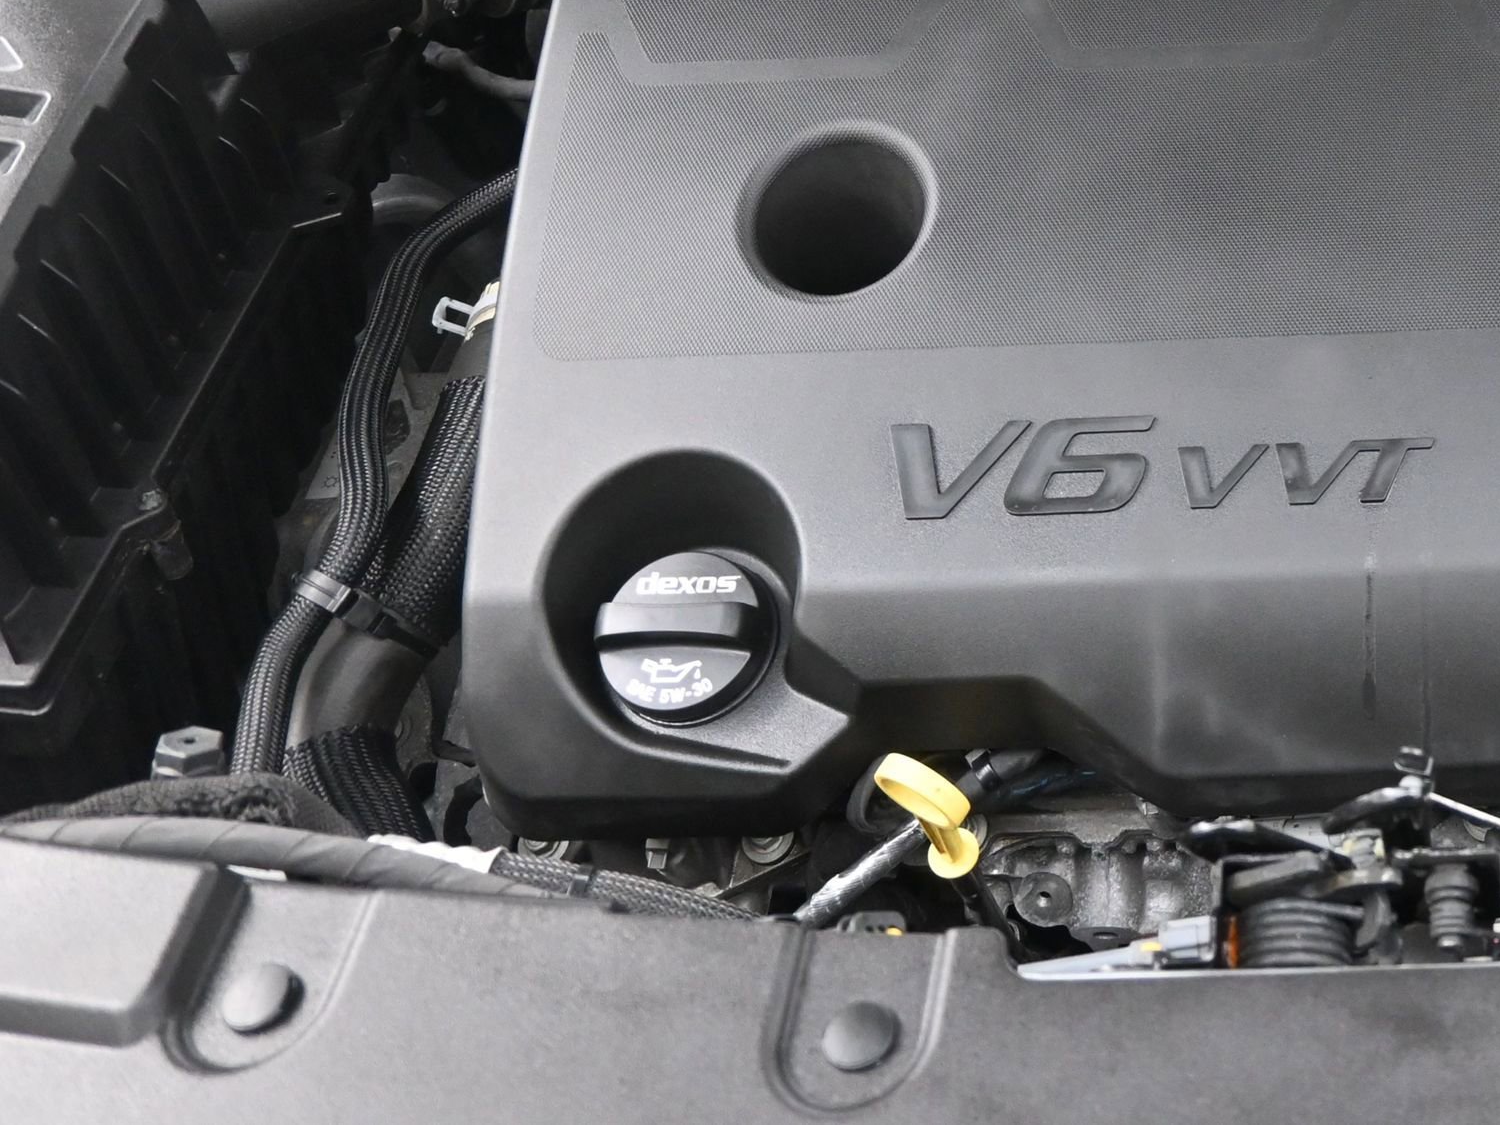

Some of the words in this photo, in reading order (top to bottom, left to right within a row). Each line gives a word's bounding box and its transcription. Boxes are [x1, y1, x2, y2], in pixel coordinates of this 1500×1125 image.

[890, 415, 1157, 520] V6
[1178, 436, 1436, 510] VVT
[636, 571, 742, 595] dexos
[626, 678, 656, 703] SAE
[659, 677, 714, 704] 5W-30
